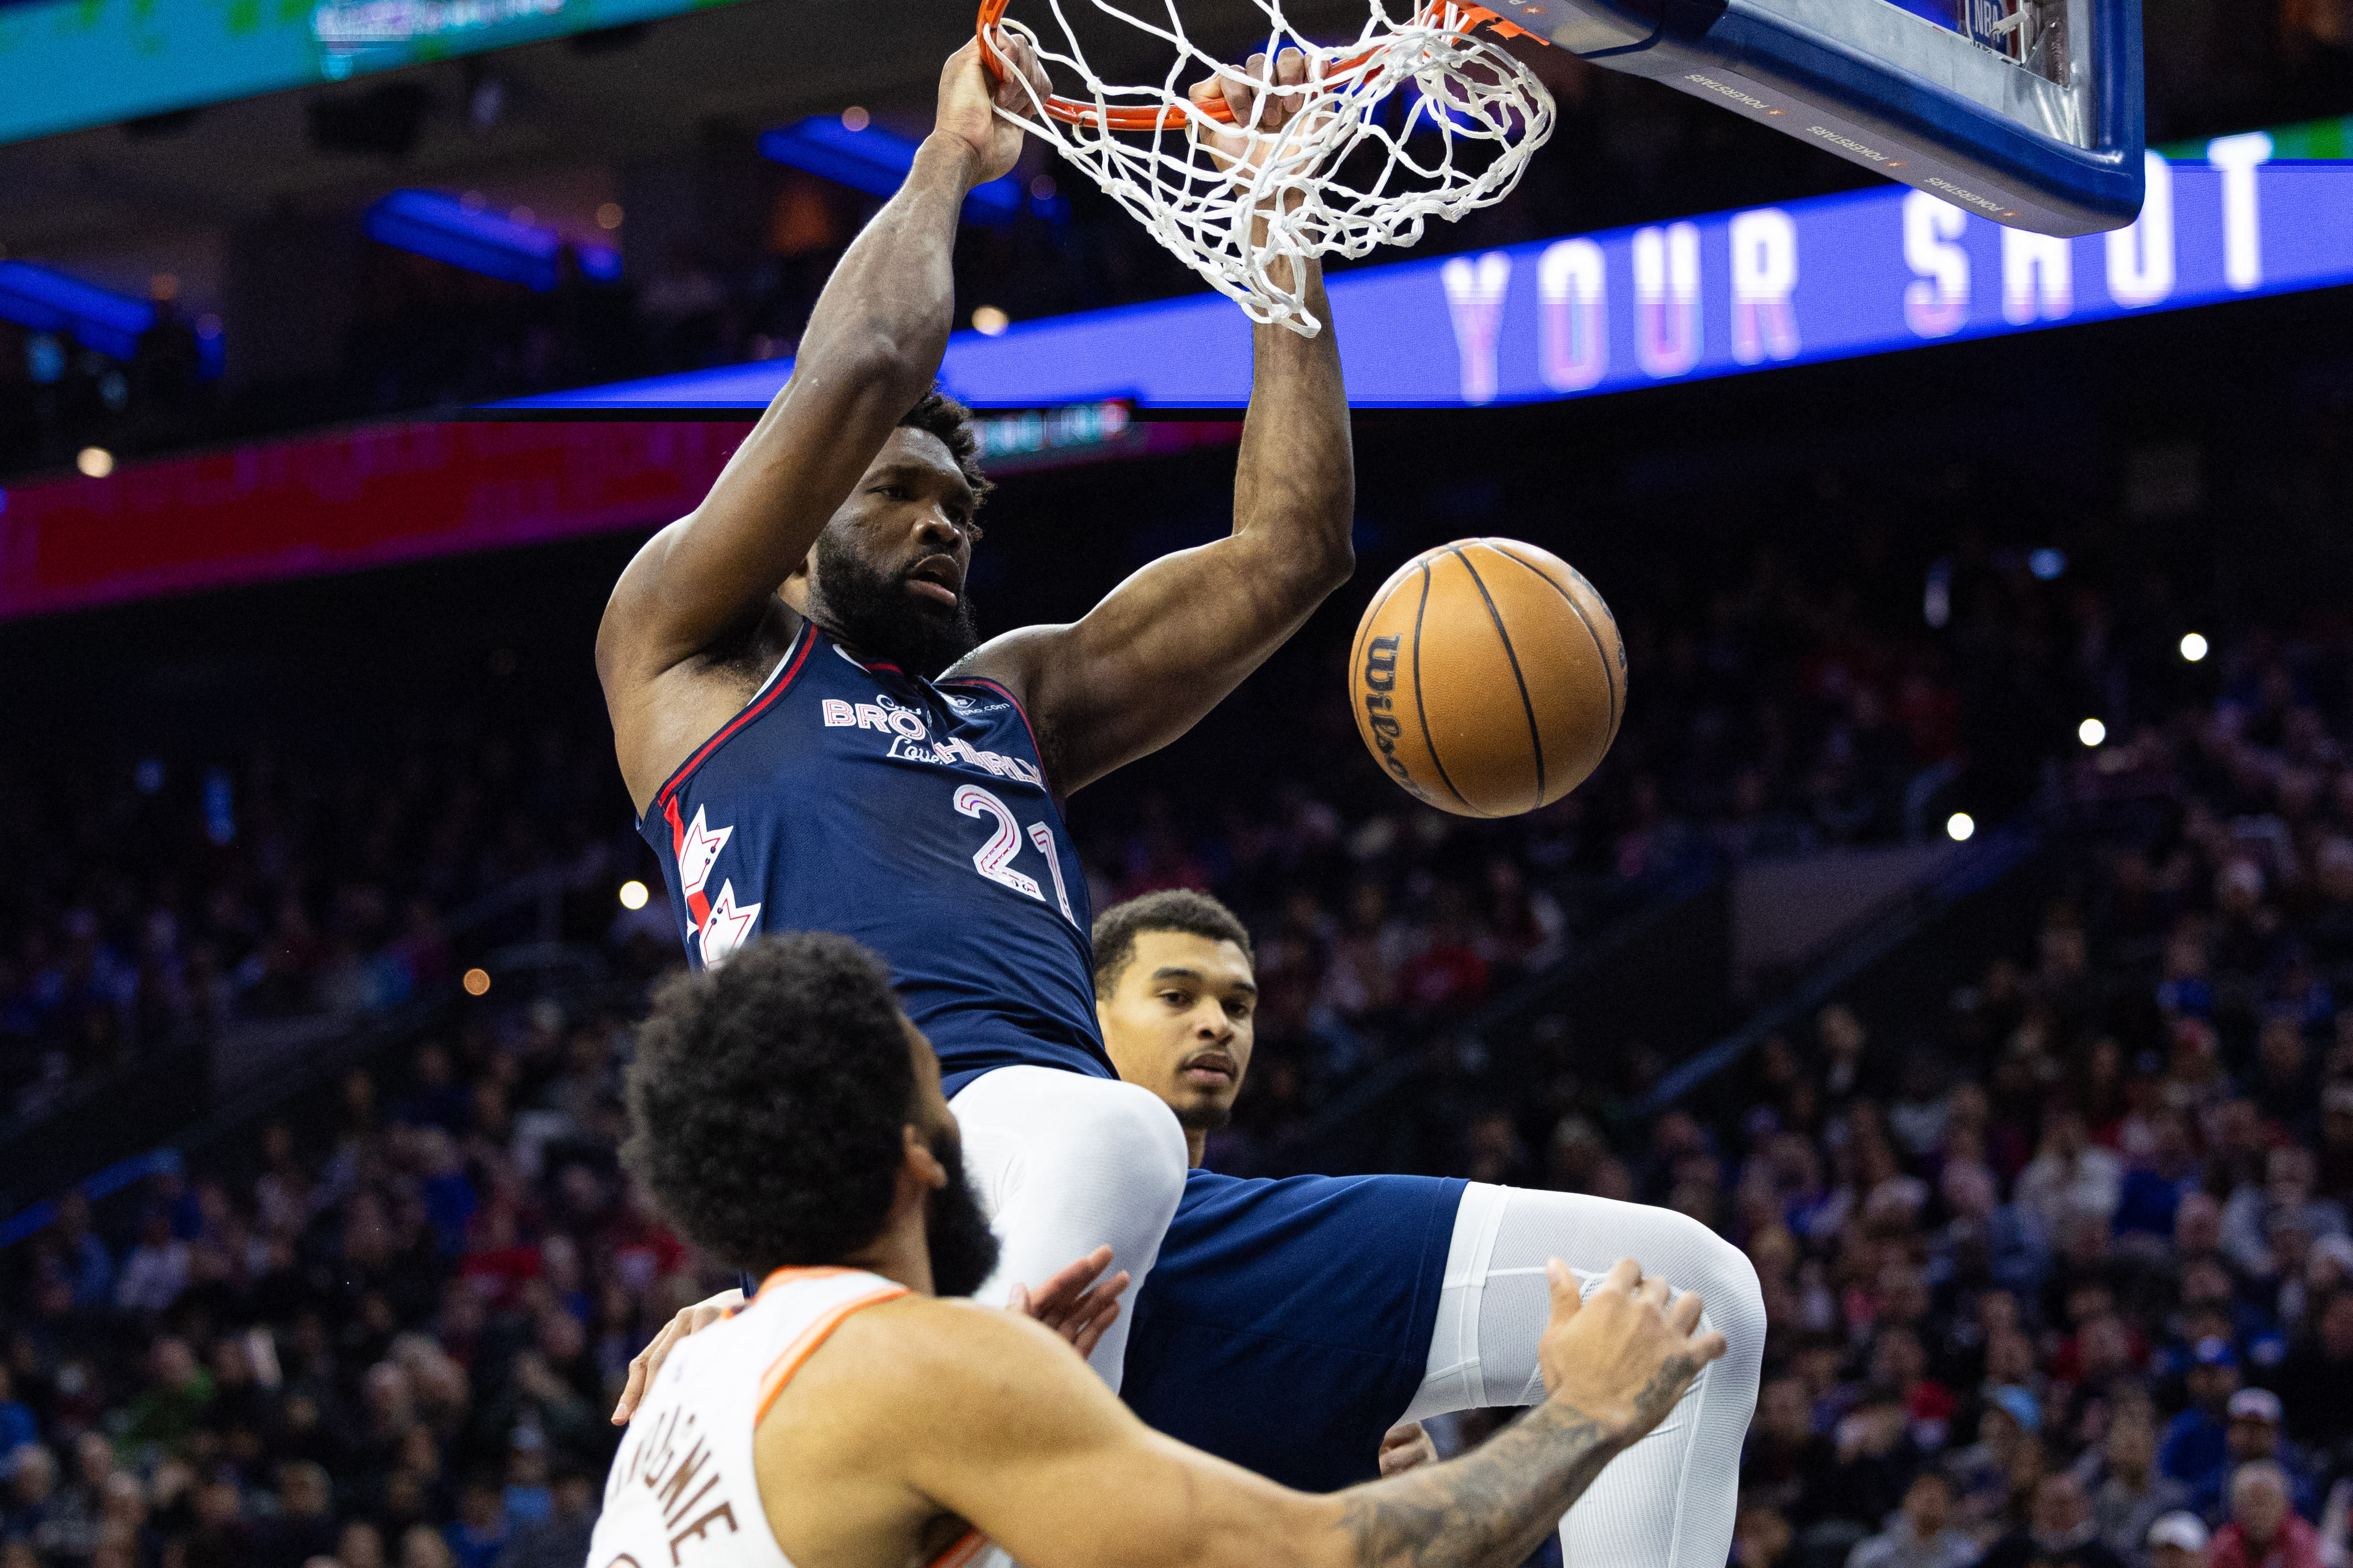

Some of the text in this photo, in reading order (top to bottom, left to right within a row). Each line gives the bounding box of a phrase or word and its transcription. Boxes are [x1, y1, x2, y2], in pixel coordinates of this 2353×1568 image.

[1974, 0, 2000, 43] NBA
[1684, 74, 1770, 109] POKERSTARS
[1806, 125, 1890, 162] POKERSTARS
[1924, 176, 2006, 213] POKERSTARS
[1441, 208, 1801, 405] YOUR
[953, 784, 1082, 932] 21
